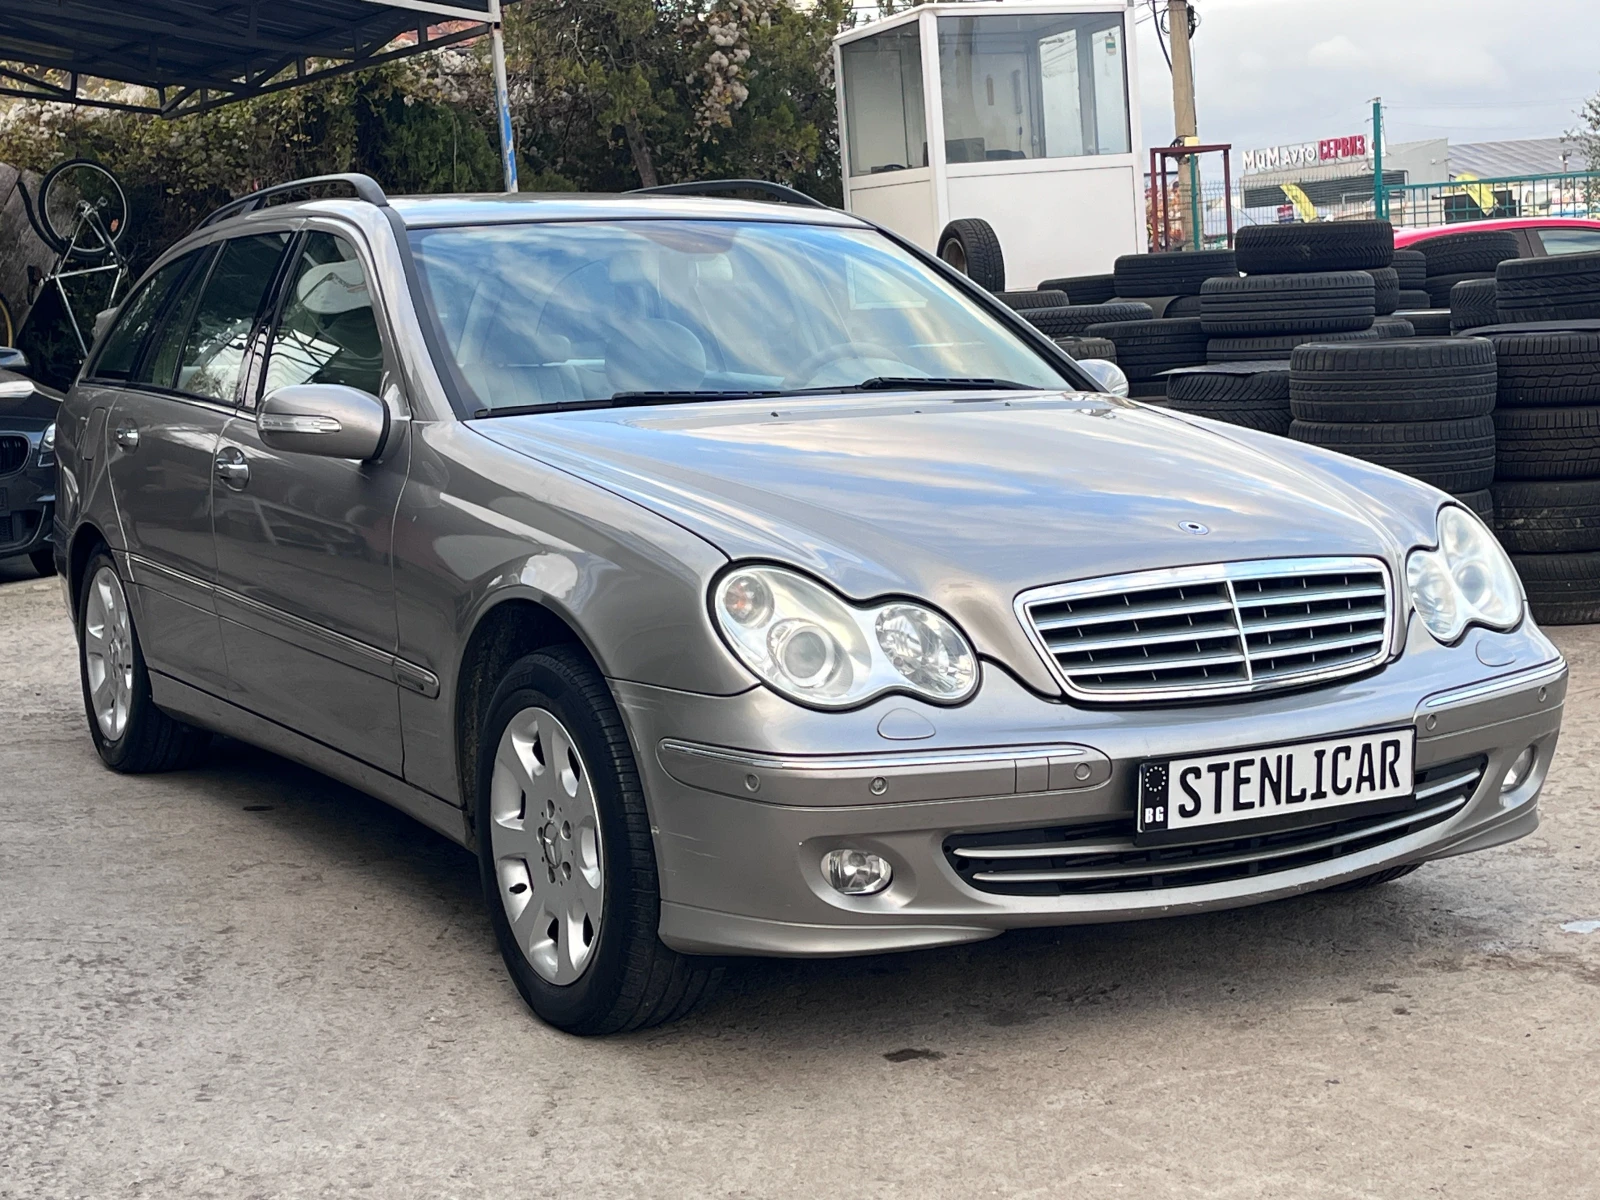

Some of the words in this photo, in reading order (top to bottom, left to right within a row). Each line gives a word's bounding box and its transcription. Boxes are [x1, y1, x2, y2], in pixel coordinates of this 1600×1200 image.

[1319, 135, 1366, 160] СЕРВИЗ
[1178, 739, 1400, 818] STENLICAR
[1145, 807, 1164, 823] BG
